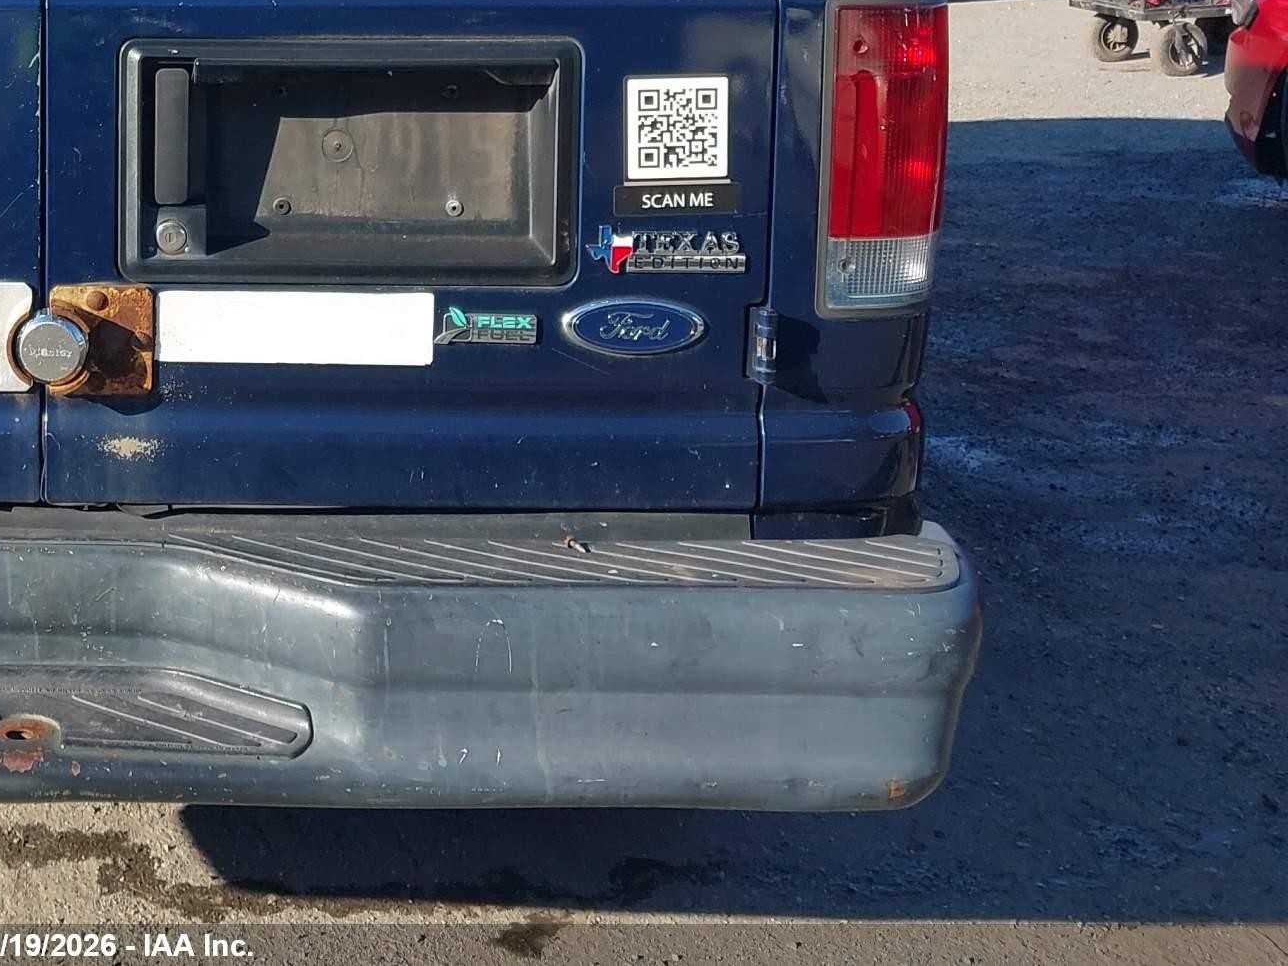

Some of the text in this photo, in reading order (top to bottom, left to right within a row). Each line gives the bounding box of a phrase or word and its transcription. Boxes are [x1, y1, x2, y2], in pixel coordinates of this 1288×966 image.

[641, 192, 714, 209] SCAN ME
[631, 230, 740, 255] TEXAS
[633, 257, 739, 271] EDITION
[476, 314, 534, 329] FLEX
[599, 311, 669, 341] Ford
[476, 329, 532, 341] FUEL
